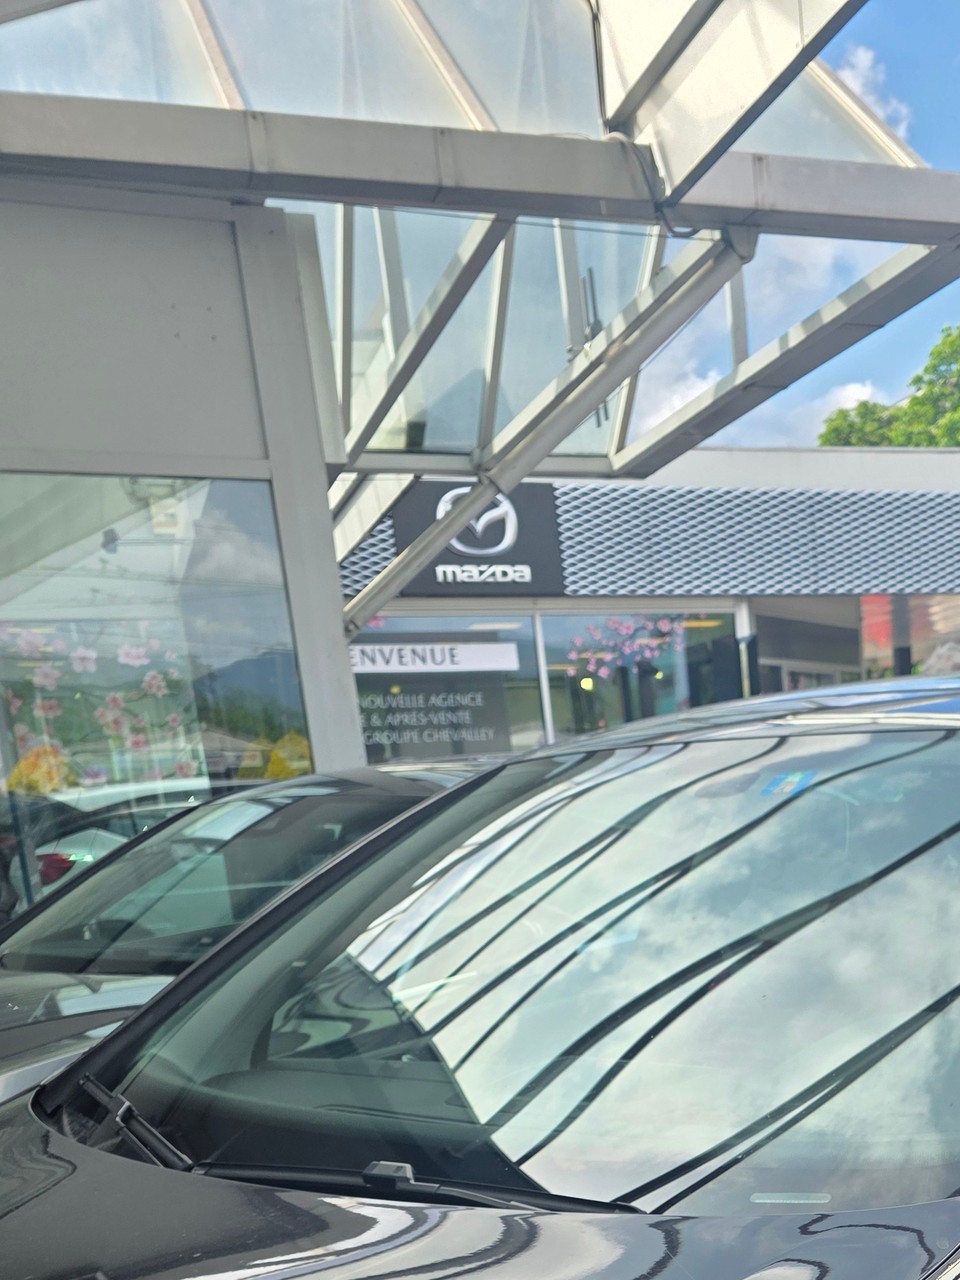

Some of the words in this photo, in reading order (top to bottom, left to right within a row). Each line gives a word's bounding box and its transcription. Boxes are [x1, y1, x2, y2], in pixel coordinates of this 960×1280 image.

[435, 564, 532, 583] mazda
[428, 692, 484, 707] AGENCE
[364, 730, 420, 745] GROUPE
[422, 727, 495, 743] CHEVALLEY
